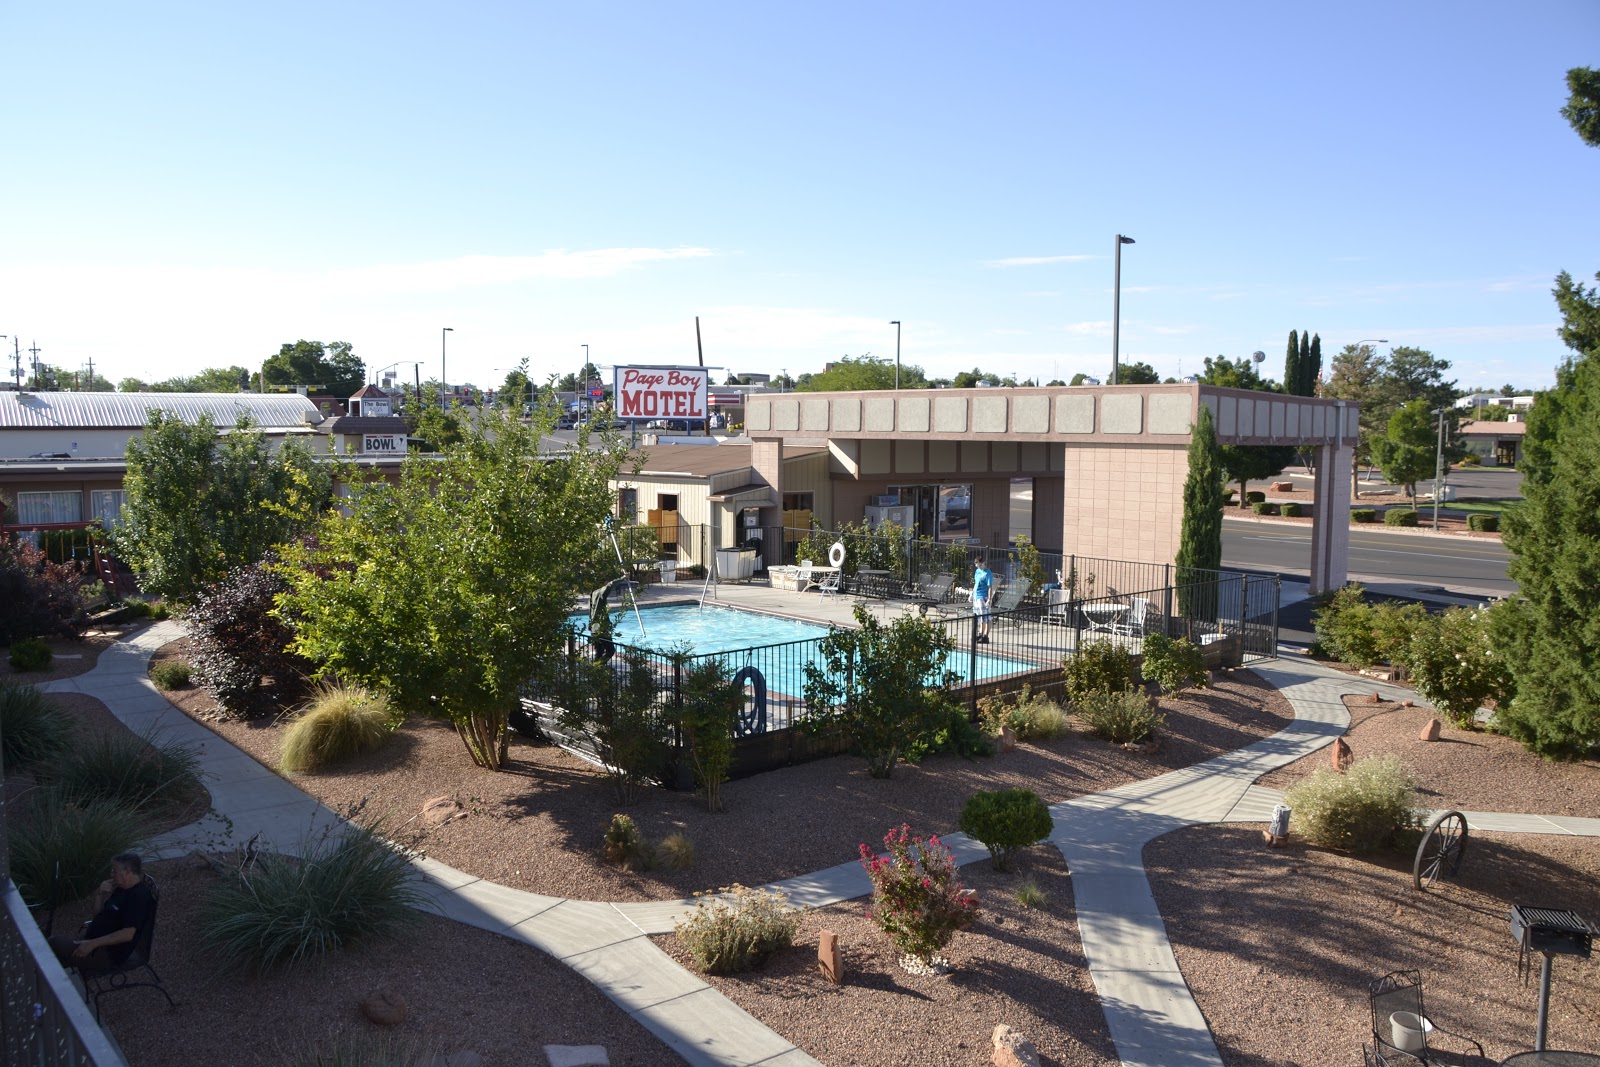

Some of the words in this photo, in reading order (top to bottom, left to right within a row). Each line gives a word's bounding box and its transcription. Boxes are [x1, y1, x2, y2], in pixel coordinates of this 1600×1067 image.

[623, 369, 664, 389] Page
[668, 370, 702, 391] Boy
[621, 390, 702, 417] MOTEL
[365, 438, 396, 451] BOWL
